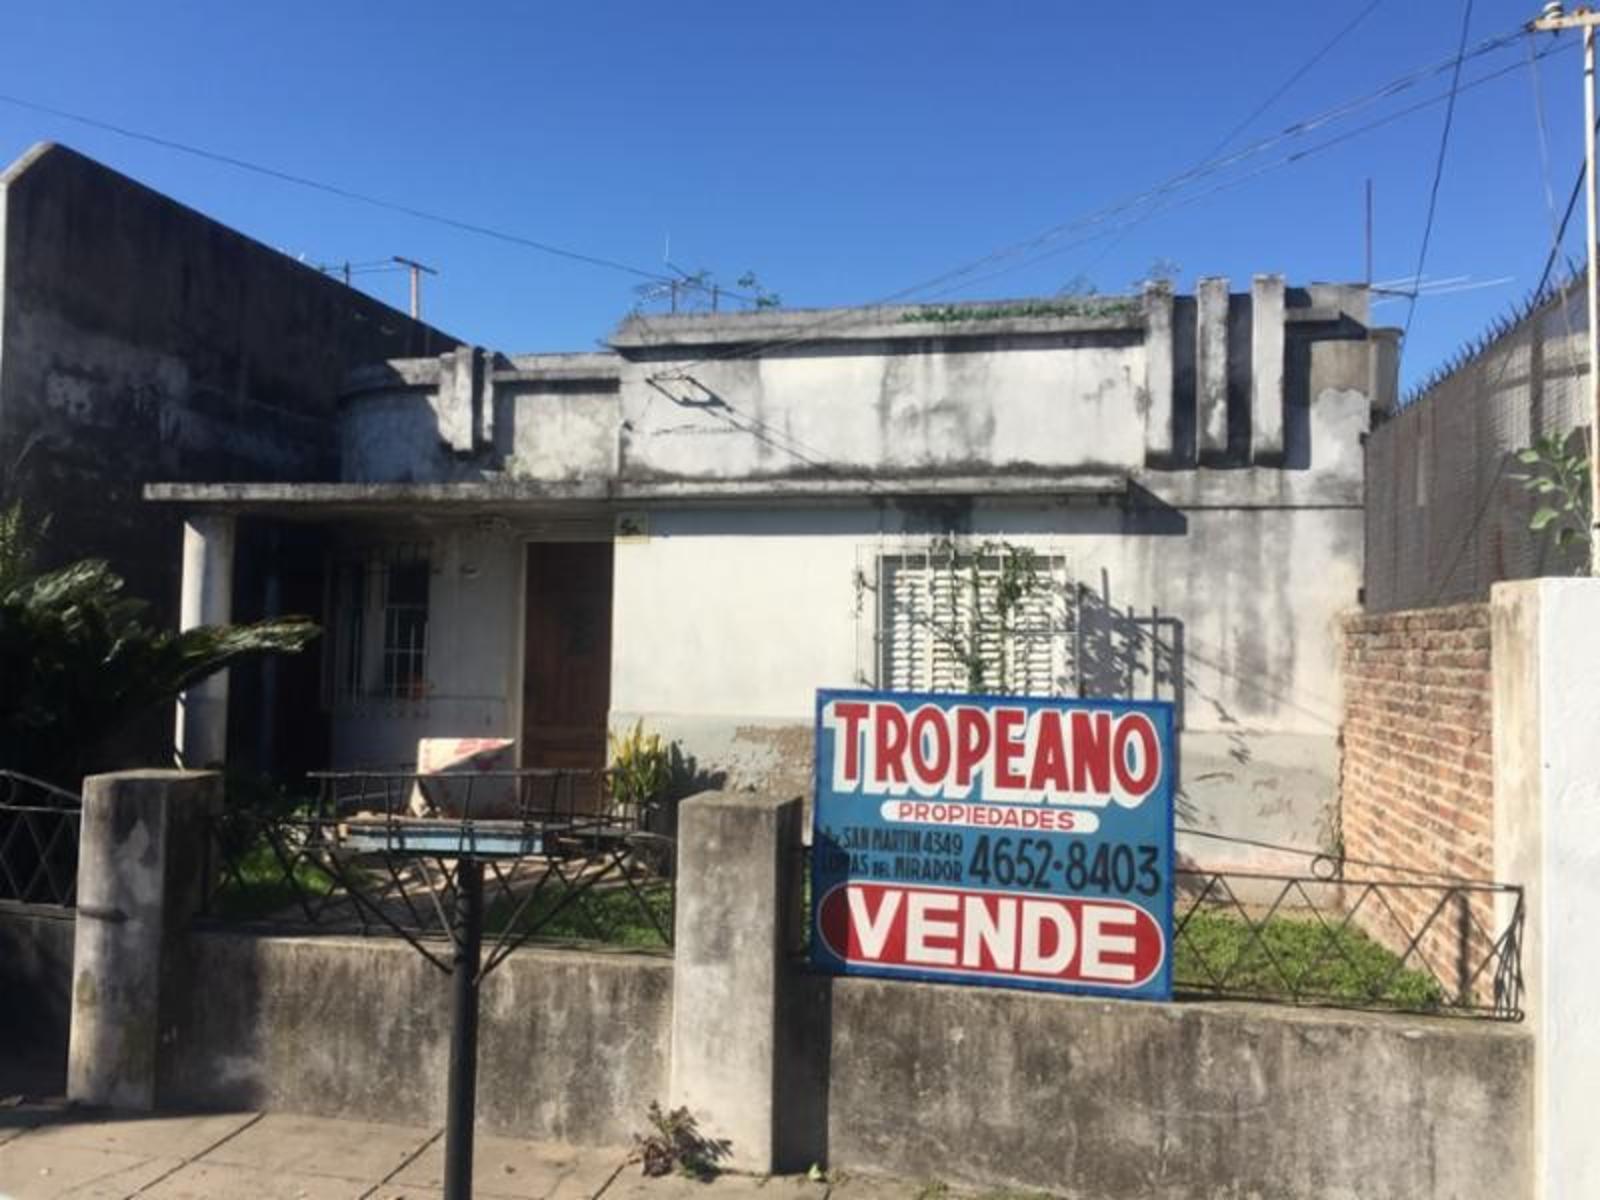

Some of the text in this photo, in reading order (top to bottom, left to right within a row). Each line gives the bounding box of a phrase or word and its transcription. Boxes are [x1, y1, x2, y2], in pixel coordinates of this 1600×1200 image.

[827, 701, 1161, 802] TROPEANO
[898, 802, 1076, 830] PROPIEDADES
[843, 827, 869, 849] SAN
[872, 827, 921, 852] MARTIN
[923, 831, 963, 856] 4349
[895, 856, 963, 882] MIRADOR
[847, 887, 1137, 982] VENDE
